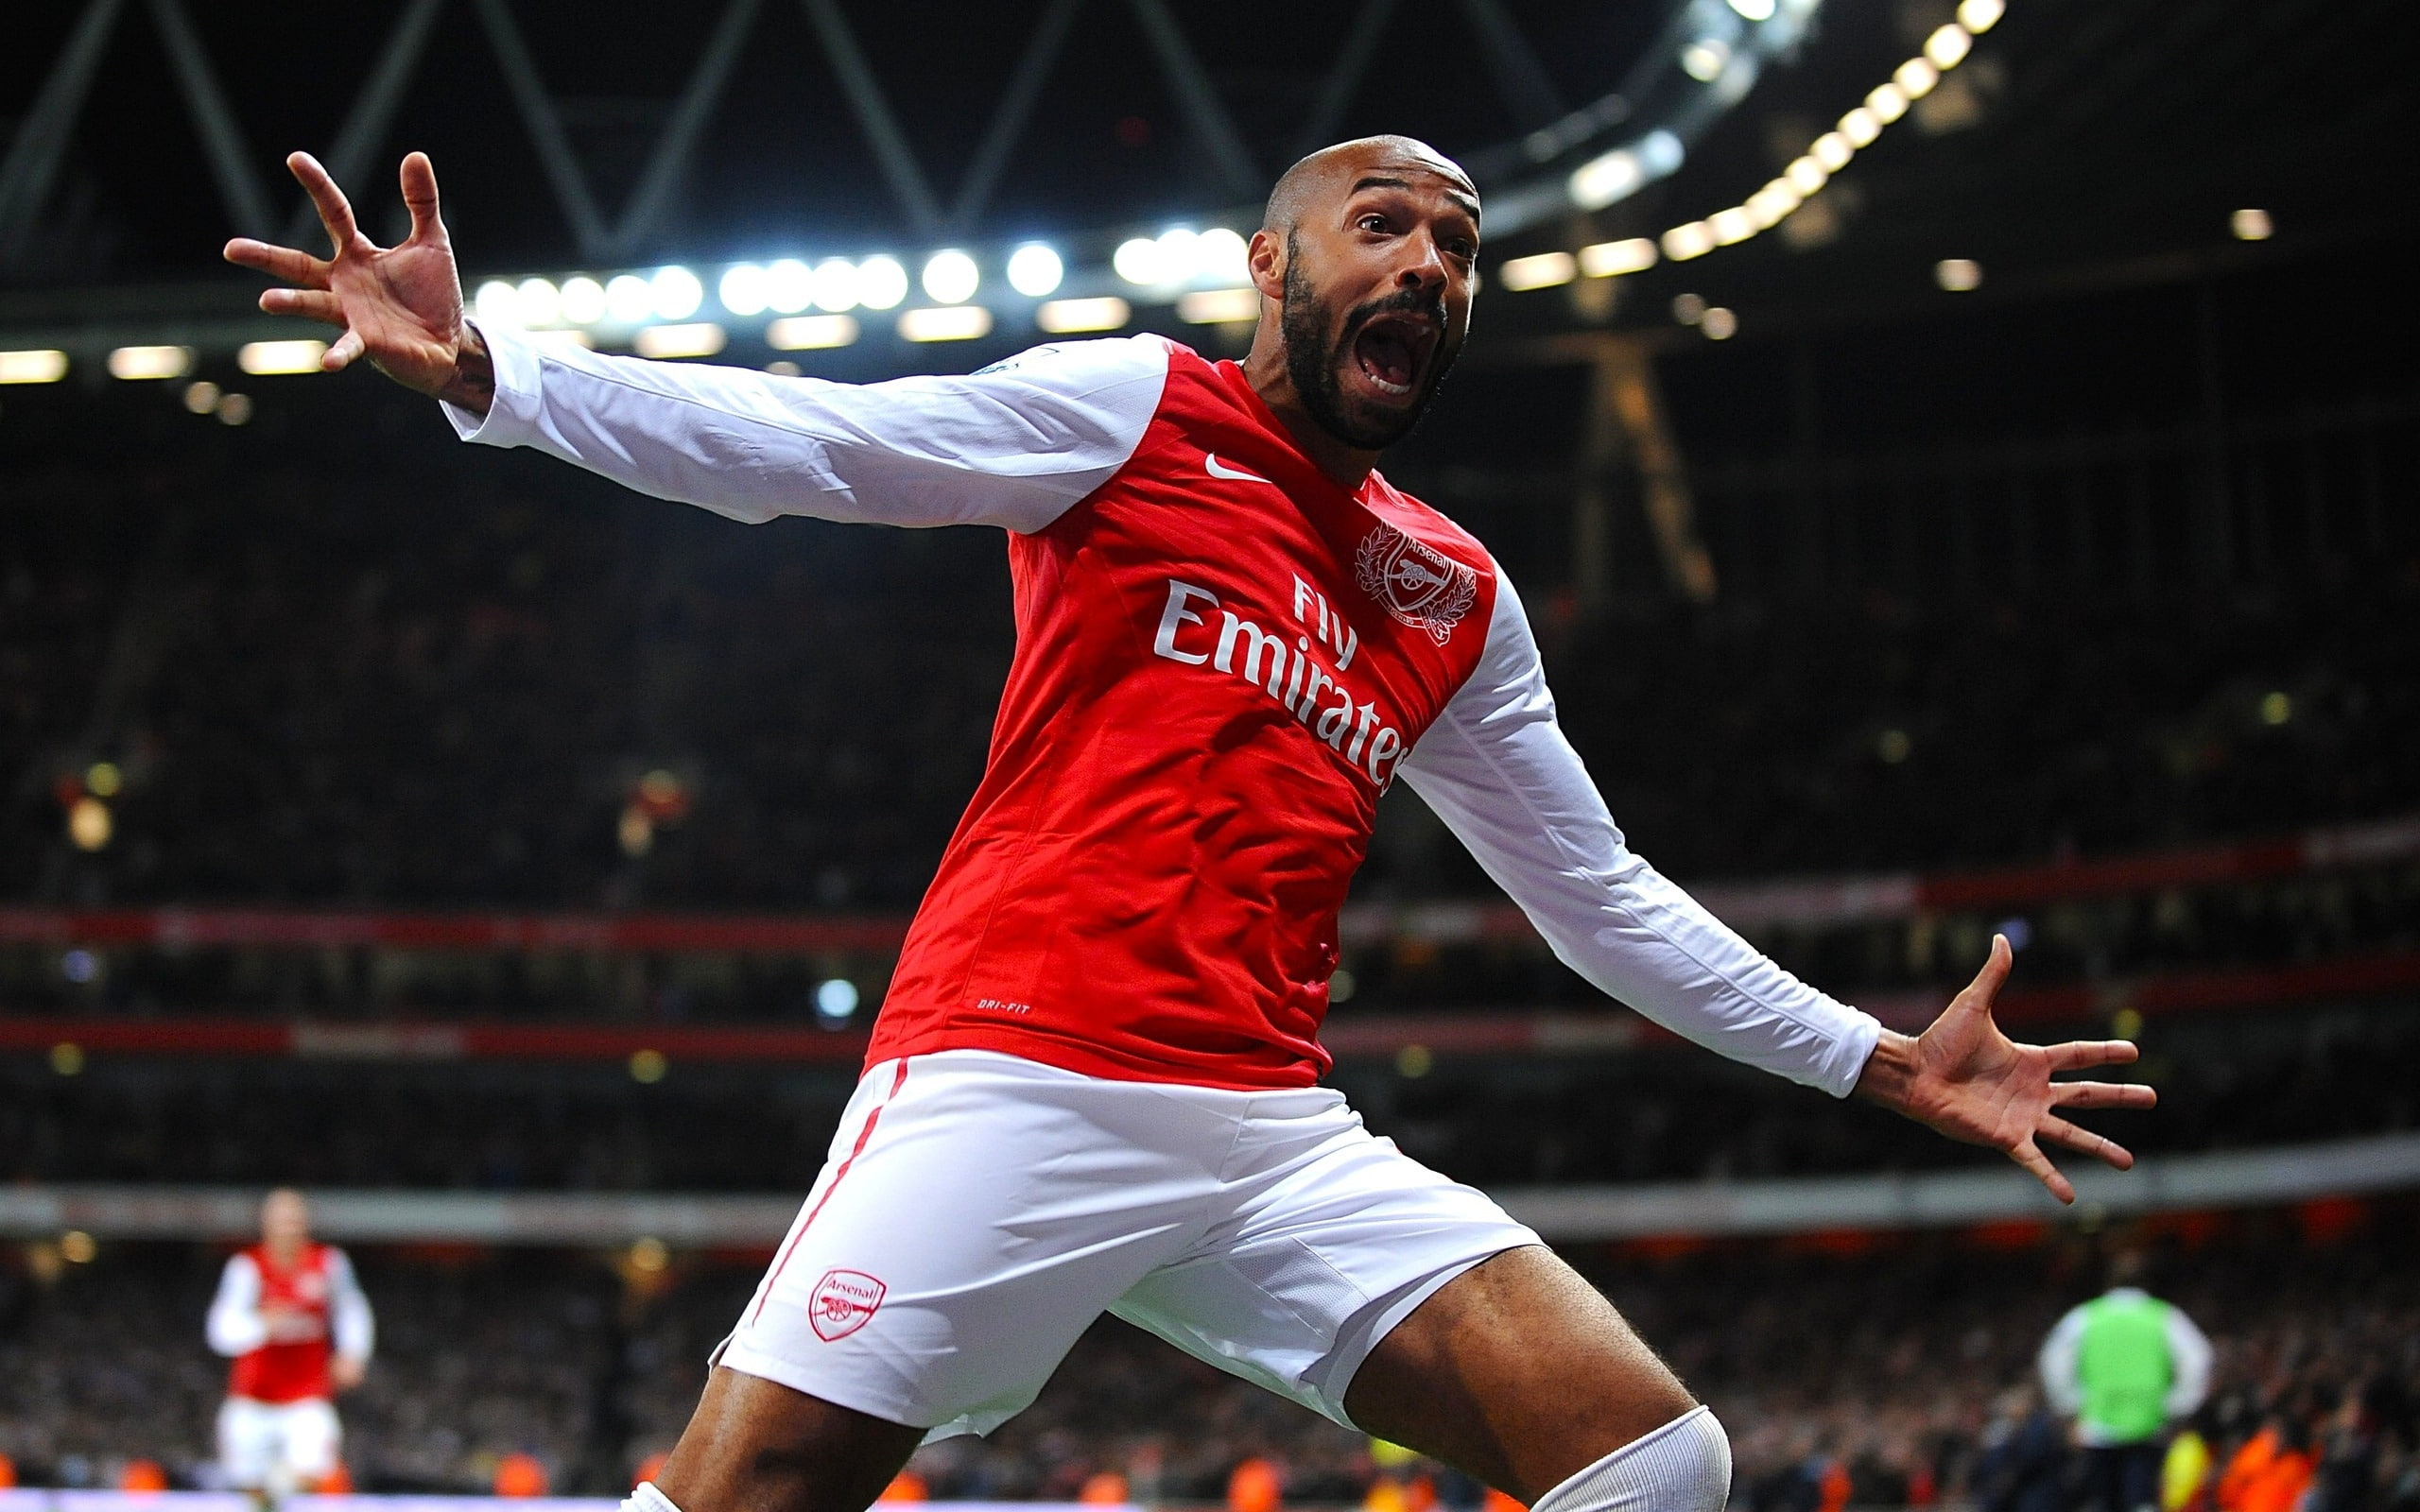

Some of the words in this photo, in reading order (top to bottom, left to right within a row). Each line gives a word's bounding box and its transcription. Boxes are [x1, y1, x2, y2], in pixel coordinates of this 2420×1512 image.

[1408, 540, 1446, 569] Arsenal
[1292, 571, 1357, 672] Fly
[977, 999, 1030, 1014] DRI-FIT
[827, 1280, 874, 1299] Arsenal
